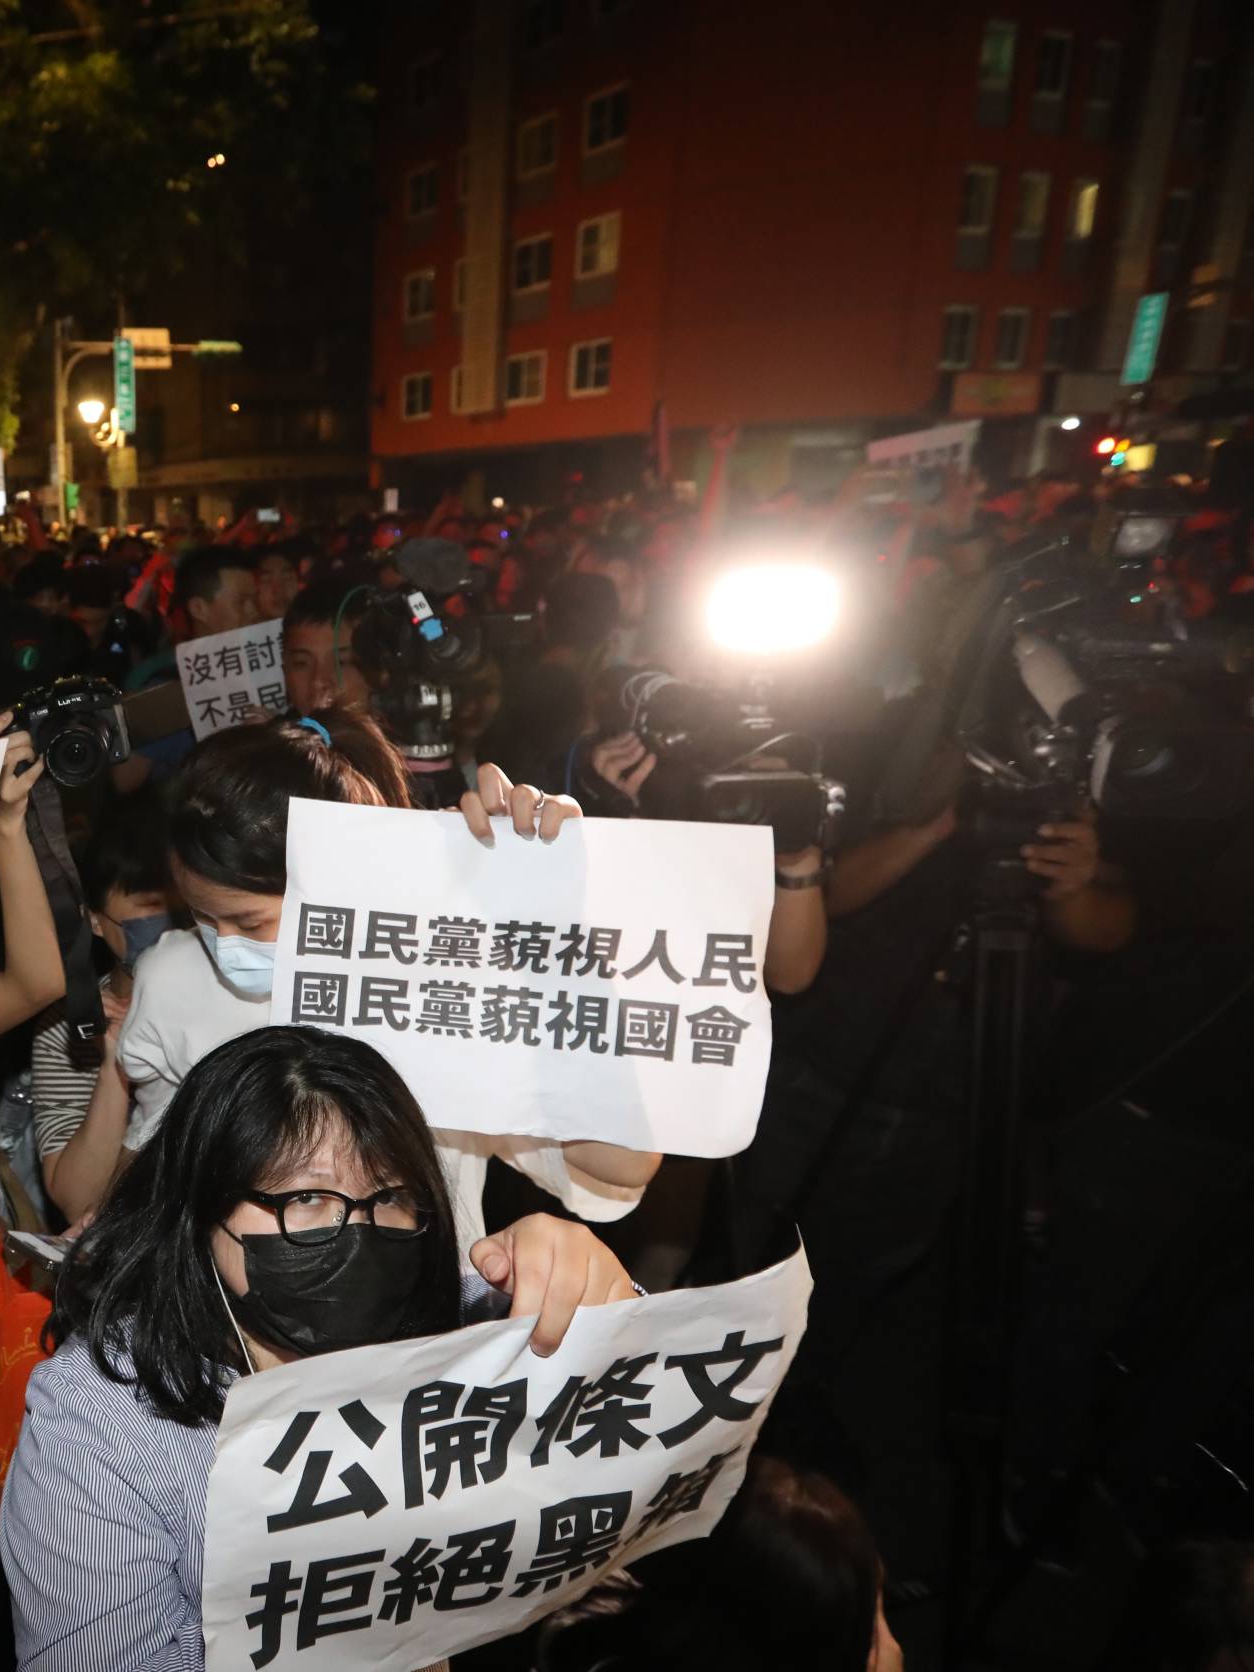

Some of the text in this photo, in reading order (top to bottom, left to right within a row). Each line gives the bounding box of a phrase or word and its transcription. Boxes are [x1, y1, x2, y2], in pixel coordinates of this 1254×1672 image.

[184, 632, 283, 686] 沒有討
[296, 902, 758, 993] 國民黨藐視人民
[291, 971, 751, 1067] 國民黨藐視國會
[264, 1330, 786, 1533] 公開條文
[245, 1445, 742, 1671] 拒絕黑箱
